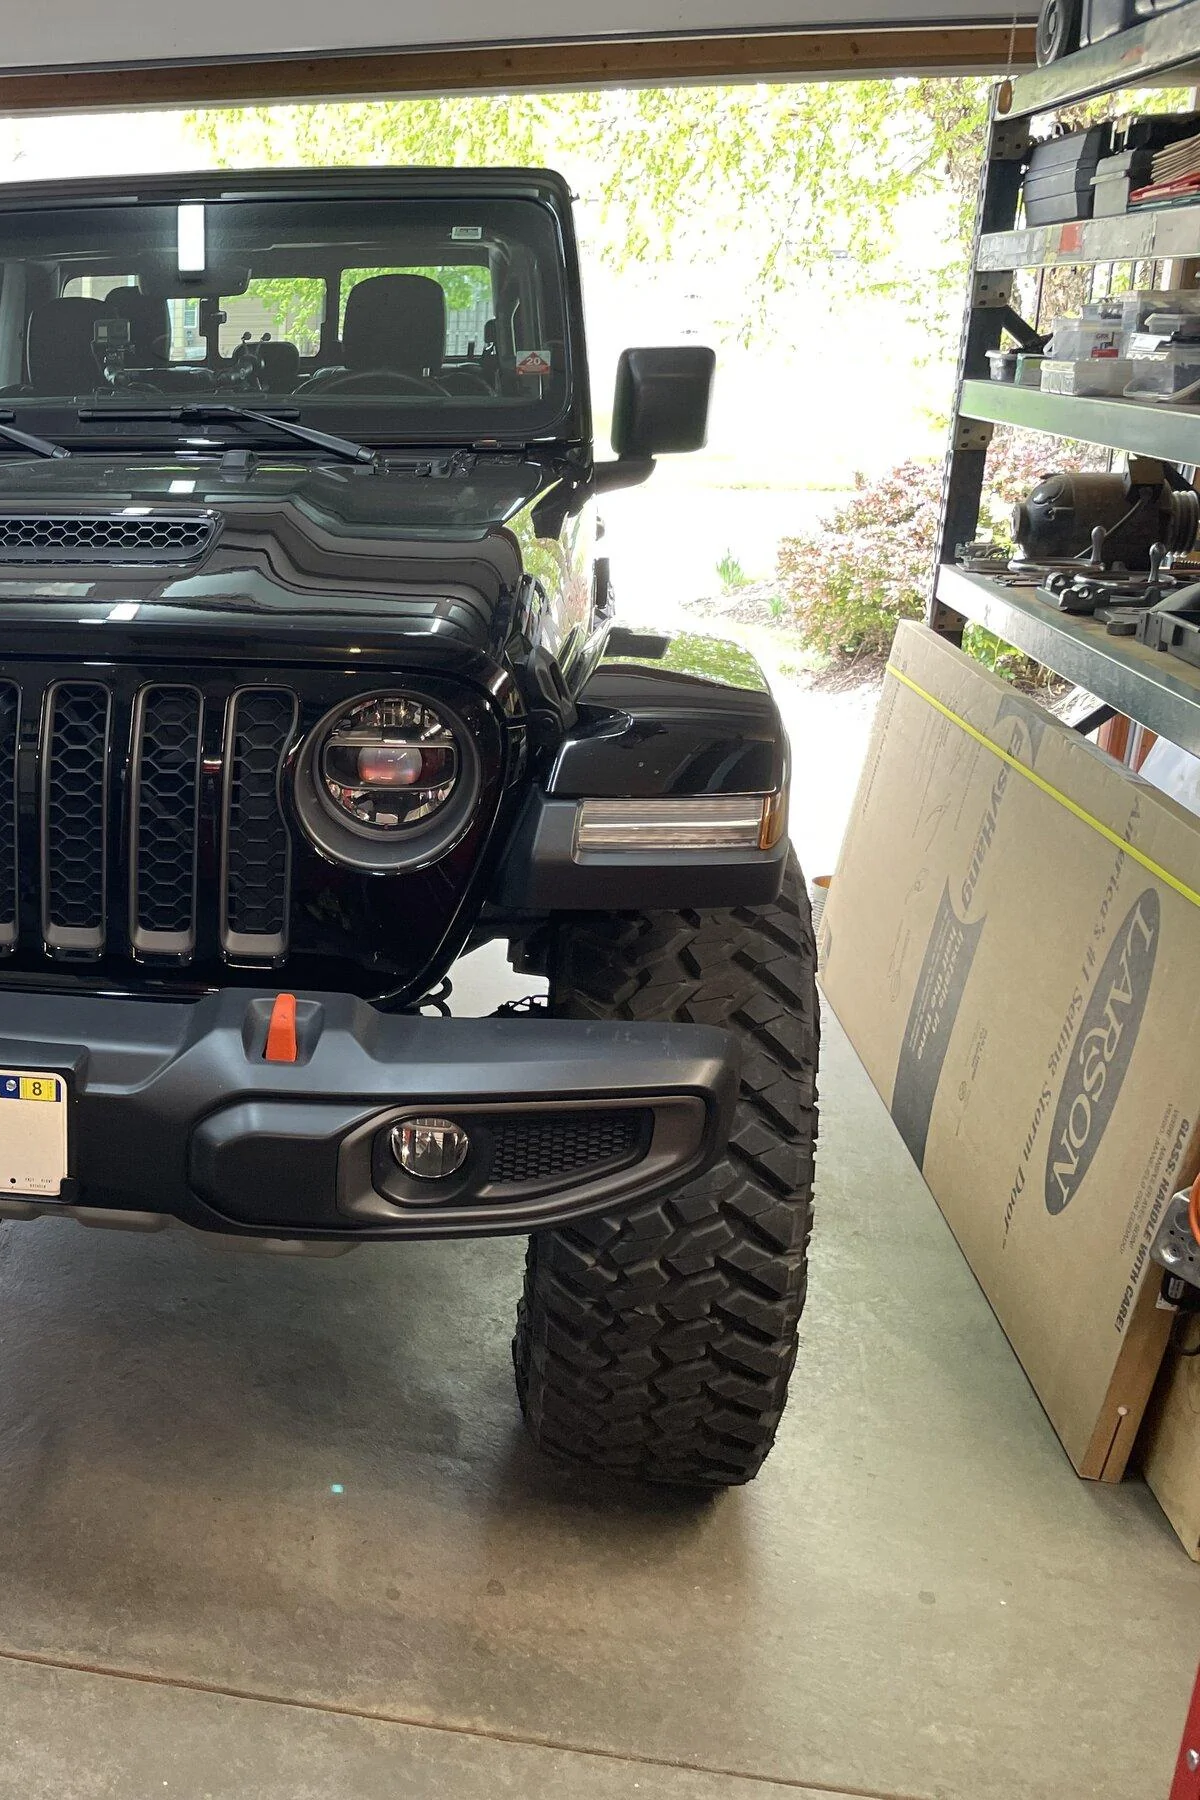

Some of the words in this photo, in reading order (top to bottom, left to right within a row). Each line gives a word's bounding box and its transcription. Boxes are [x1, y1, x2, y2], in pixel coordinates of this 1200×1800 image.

[526, 357, 541, 365] 20
[938, 929, 964, 1009] Installs
[942, 925, 957, 971] half
[1081, 945, 1097, 982] #1
[930, 972, 943, 1009] the
[917, 1013, 932, 1060] time
[931, 1011, 940, 1034] in
[1047, 986, 1084, 1077] Selling
[1052, 901, 1153, 1205] LARSON
[32, 1081, 43, 1096] 8
[1023, 1081, 1052, 1162] Storm
[1165, 1118, 1190, 1176] GLASS:
[1144, 1177, 1170, 1243] HANDLE
[1130, 1243, 1148, 1285] WITH
[1114, 1285, 1134, 1333] CARE!
